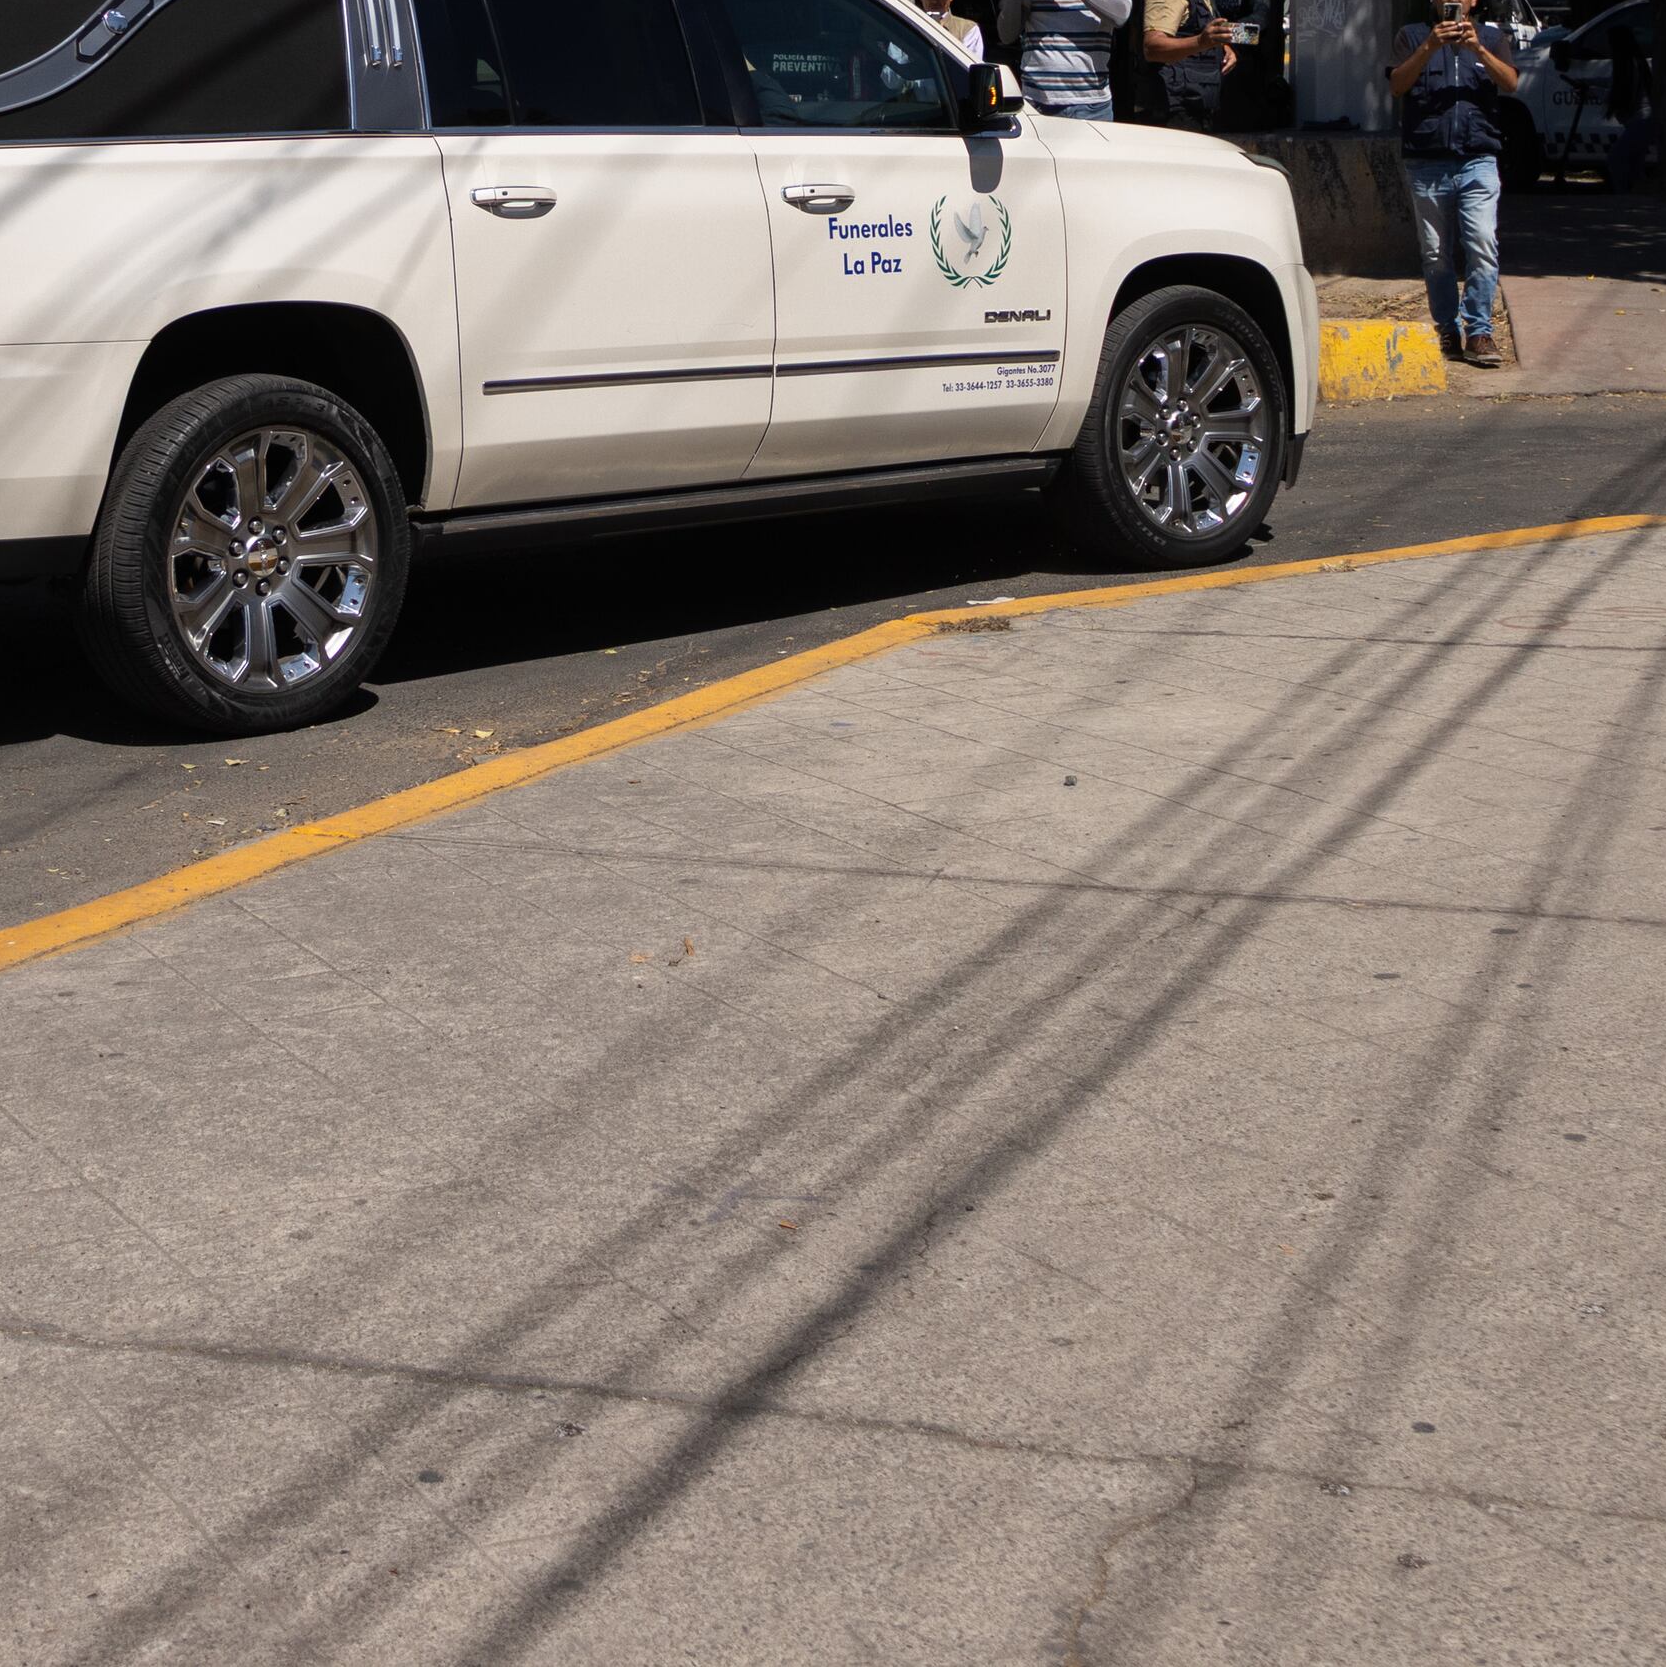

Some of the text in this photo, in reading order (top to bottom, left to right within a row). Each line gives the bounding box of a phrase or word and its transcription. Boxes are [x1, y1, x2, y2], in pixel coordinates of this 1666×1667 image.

[828, 214, 913, 239] Funerales
[843, 251, 902, 275] La Paz
[984, 309, 1051, 323] DENALI
[996, 364, 1056, 377] Gigantes No.3077
[942, 377, 1054, 392] Tel: 33-3644-1257 33-3655-3380
